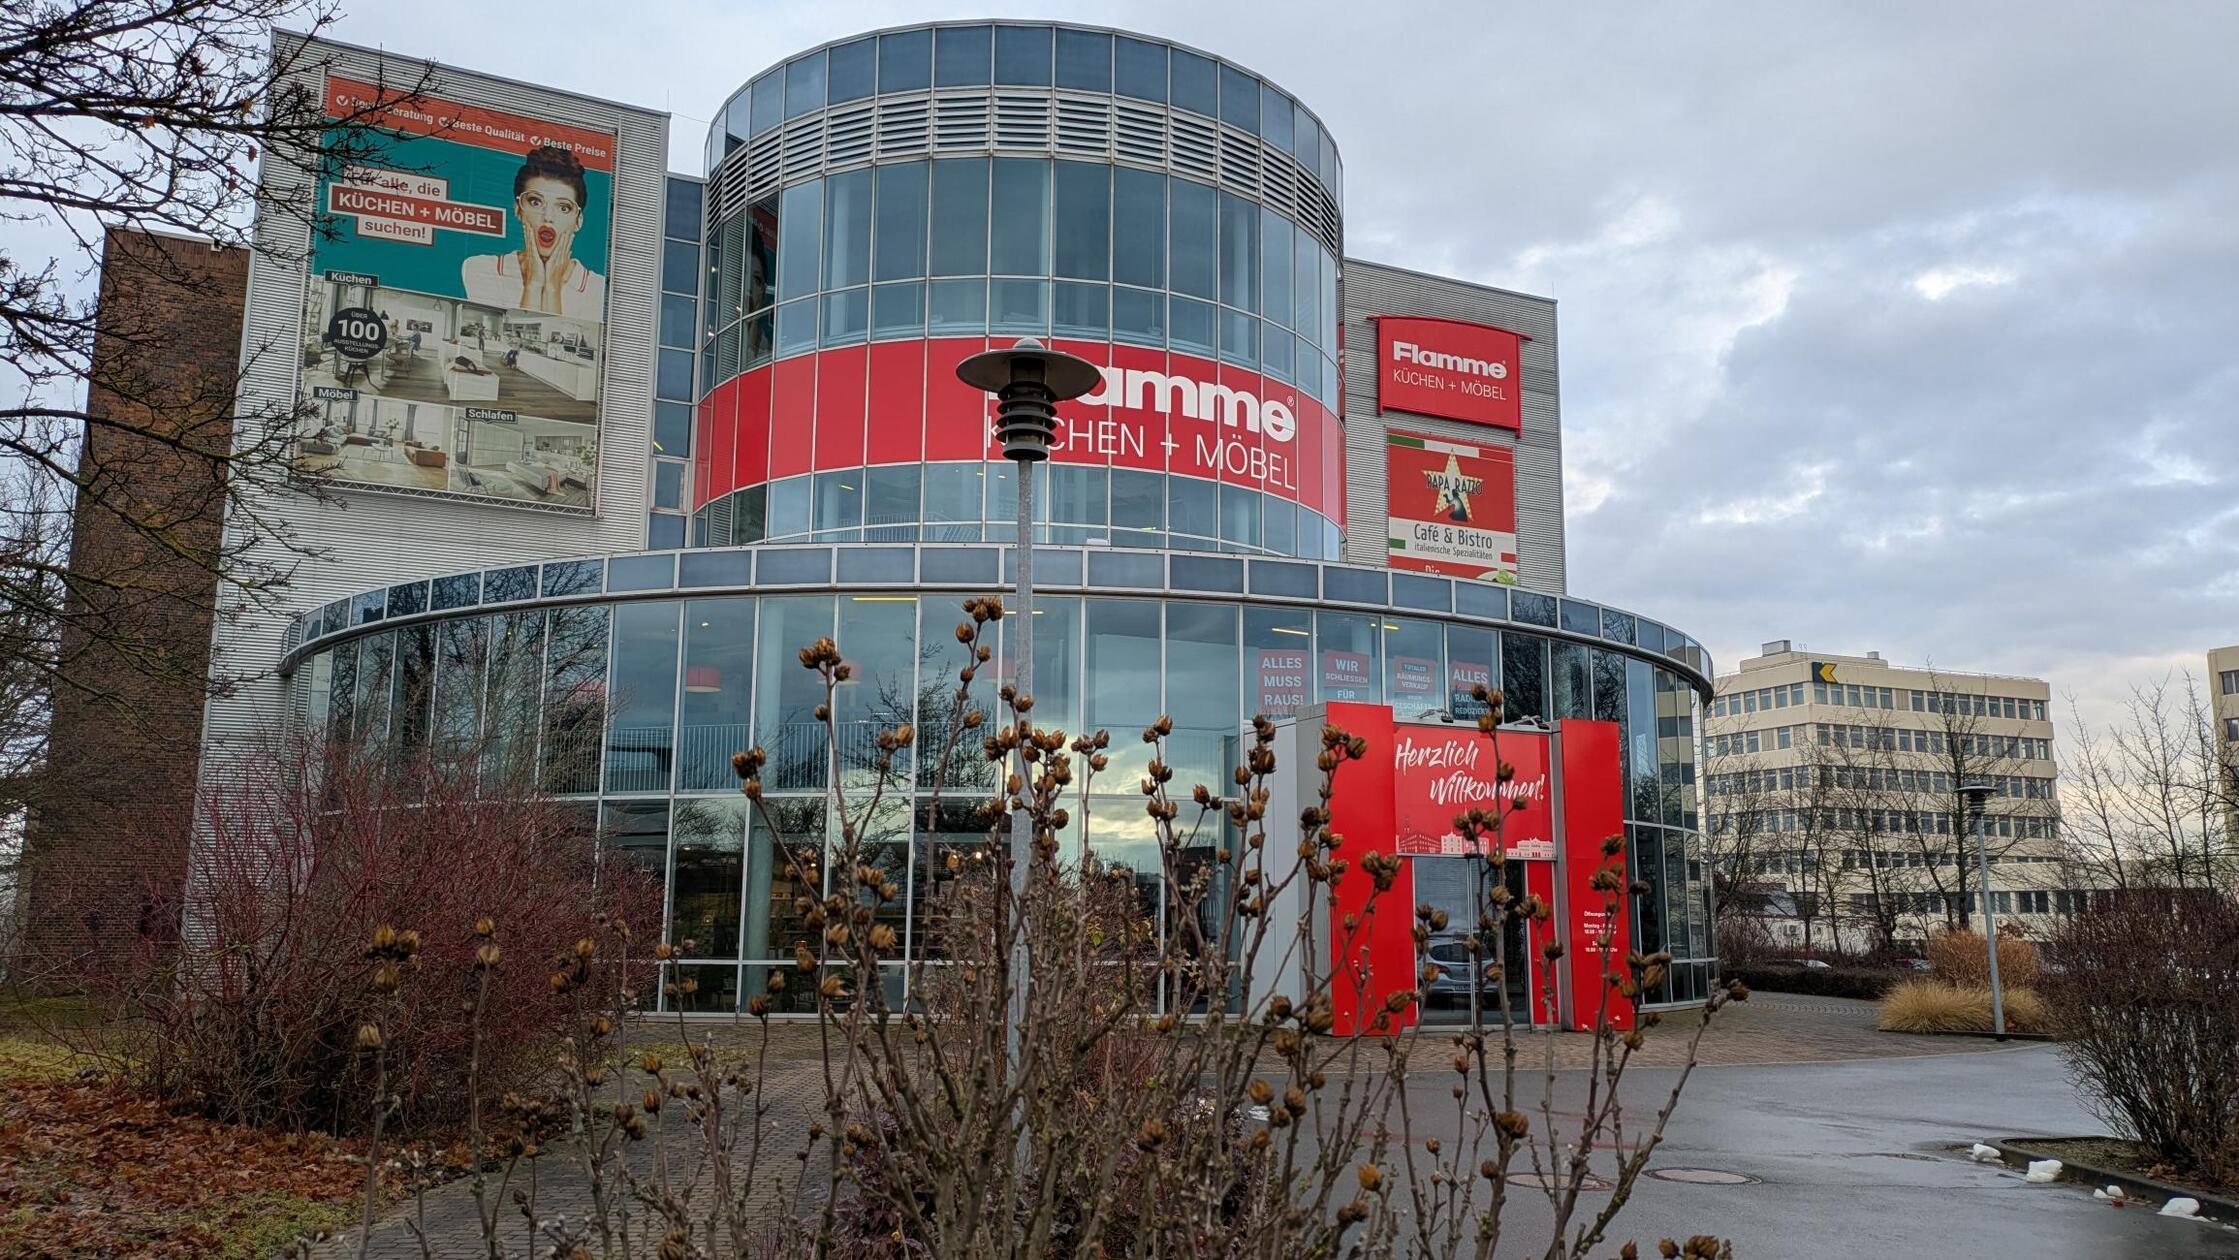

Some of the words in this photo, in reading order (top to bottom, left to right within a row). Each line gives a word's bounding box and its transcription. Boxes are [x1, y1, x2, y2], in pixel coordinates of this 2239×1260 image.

[452, 118, 483, 133] Beste
[484, 125, 526, 143] Qualität
[543, 136, 573, 151] Beste
[574, 143, 607, 158] Preise
[417, 181, 441, 197] die
[338, 191, 415, 217] KÜCHEN
[419, 208, 431, 218] +
[434, 206, 497, 229] MÖBEL
[364, 219, 427, 239] suchen!
[331, 271, 372, 285] Küchen
[350, 310, 368, 319] ÜBER
[337, 319, 380, 341] 100
[1392, 340, 1508, 380] Flamme
[1392, 367, 1445, 391] KÜCHEN
[1448, 380, 1457, 390] +
[1461, 379, 1508, 401] MÖBEL
[318, 388, 354, 400] Möbel
[468, 408, 513, 421] Schlafen
[987, 416, 1144, 458] KCHEN
[1160, 433, 1181, 457] +
[1196, 433, 1297, 491] MÖBEL
[1414, 523, 1439, 542] Café
[1443, 527, 1453, 544] &
[1458, 529, 1493, 549] Bistro
[1414, 541, 1451, 556] italienische
[1453, 547, 1493, 560] Spezialitäten
[1262, 657, 1303, 669] ALLES
[1335, 658, 1359, 672] WIR
[1264, 675, 1302, 687] MUSS
[1325, 672, 1369, 684] SCHLIESSEN
[1453, 669, 1488, 684] ALLES
[1264, 694, 1304, 705] RAUS!
[1337, 688, 1355, 699] FÜR
[1395, 737, 1480, 775] Herzlich
[1429, 770, 1546, 805] Willkommen!
